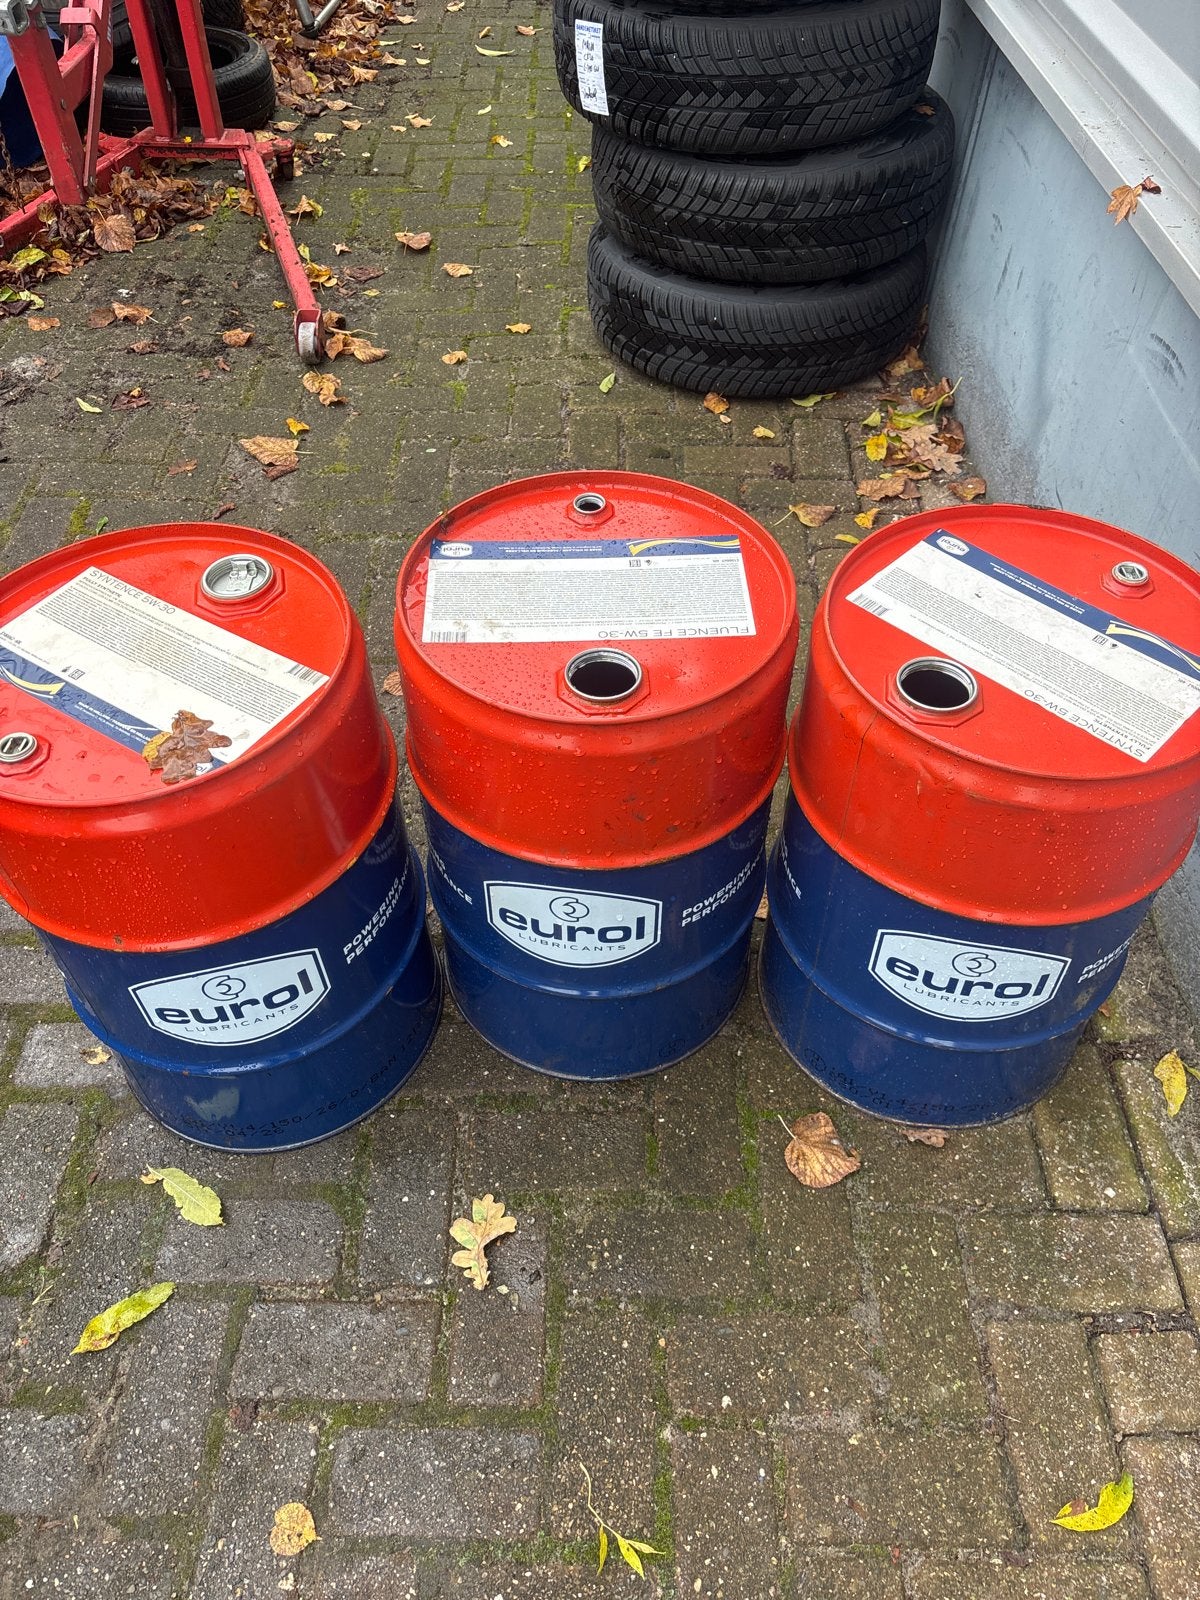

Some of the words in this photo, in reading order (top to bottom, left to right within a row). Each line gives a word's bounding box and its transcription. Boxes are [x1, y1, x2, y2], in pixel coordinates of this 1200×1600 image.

[89, 569, 144, 599] SYNTENCE
[141, 595, 176, 615] 5W-30
[598, 629, 648, 639] 5W-30
[653, 629, 673, 637] FE
[678, 626, 749, 637] FLUENCE
[1024, 689, 1069, 716] 5W-30
[1070, 716, 1145, 758] SYNTENCE
[681, 843, 765, 928] PERFORMAN
[682, 861, 751, 918] POWERING
[342, 877, 399, 956] POWERING
[499, 905, 646, 943] eurol
[518, 932, 627, 952] LUBRICANTS
[885, 955, 1051, 999] eurol
[903, 982, 1020, 1007] LUBRICANTS
[154, 968, 314, 1025] eurol
[184, 1002, 300, 1033] LUBRICANTS
